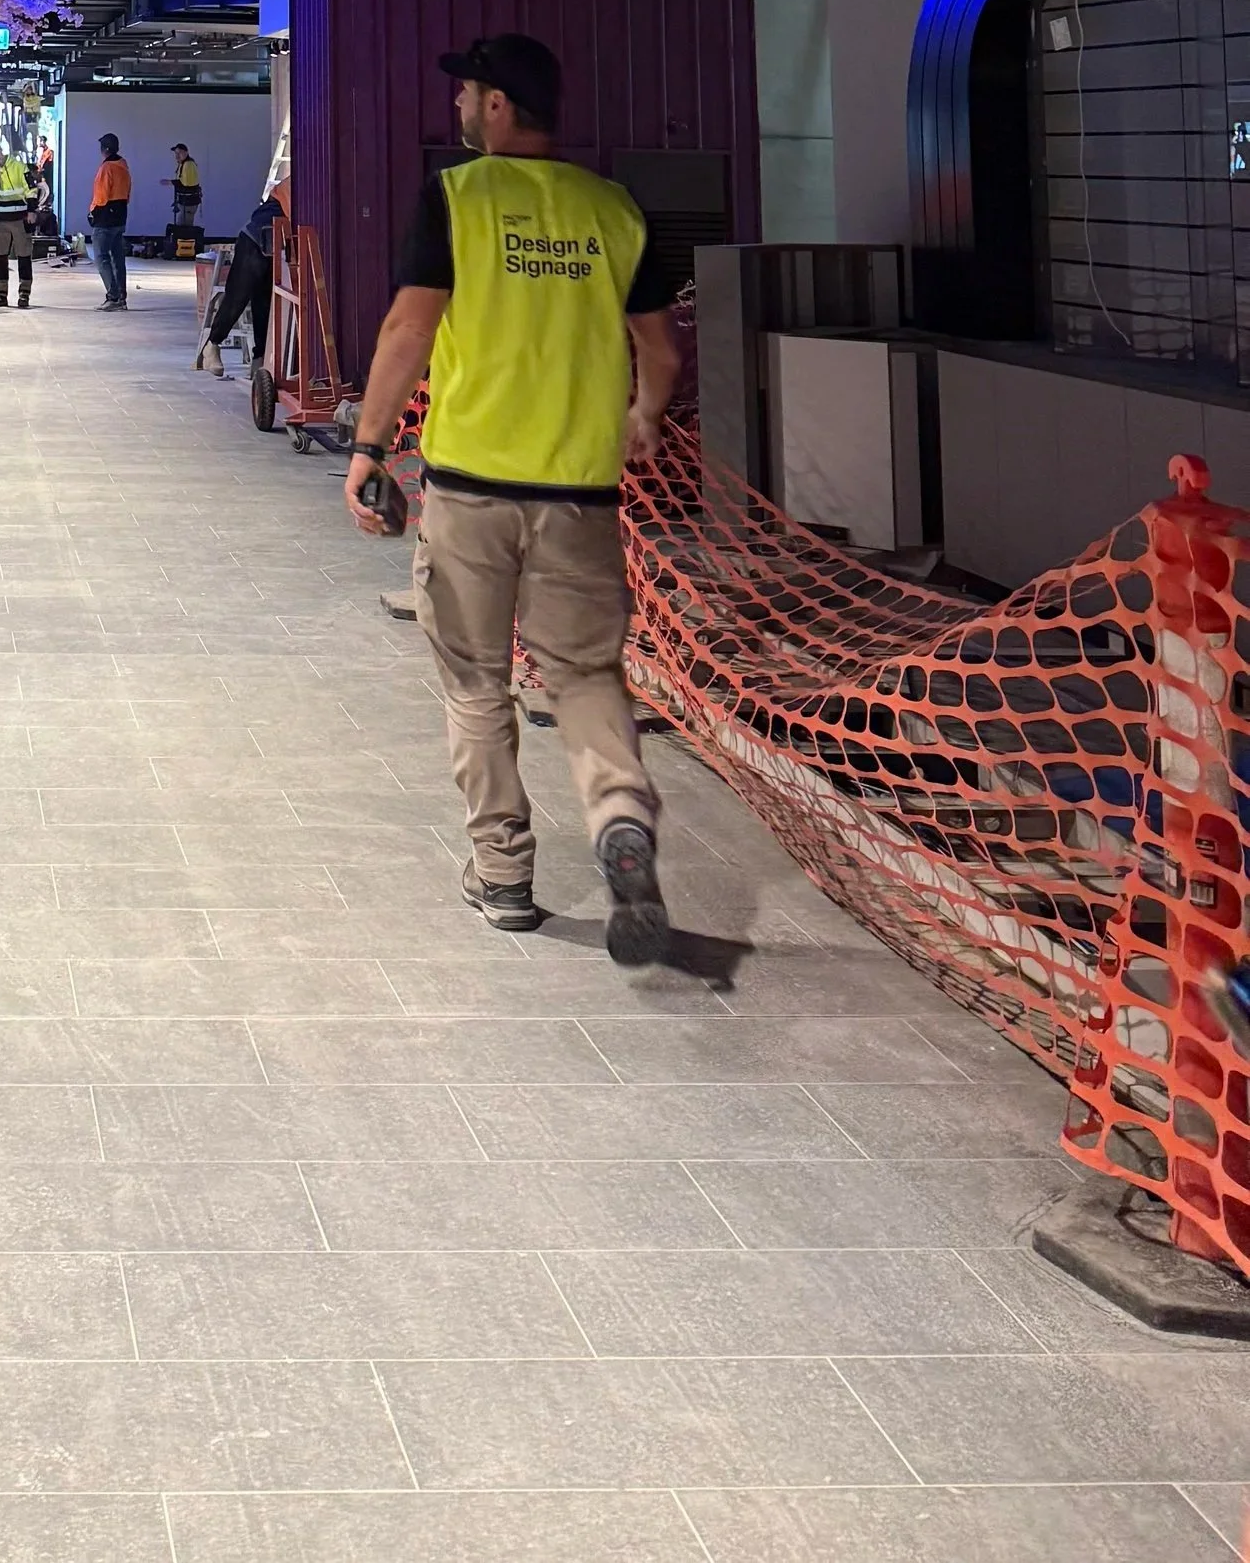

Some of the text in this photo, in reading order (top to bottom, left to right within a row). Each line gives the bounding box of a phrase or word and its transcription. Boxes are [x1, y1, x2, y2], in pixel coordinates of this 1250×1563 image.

[505, 233, 601, 258] Design &
[506, 254, 592, 279] Signage
